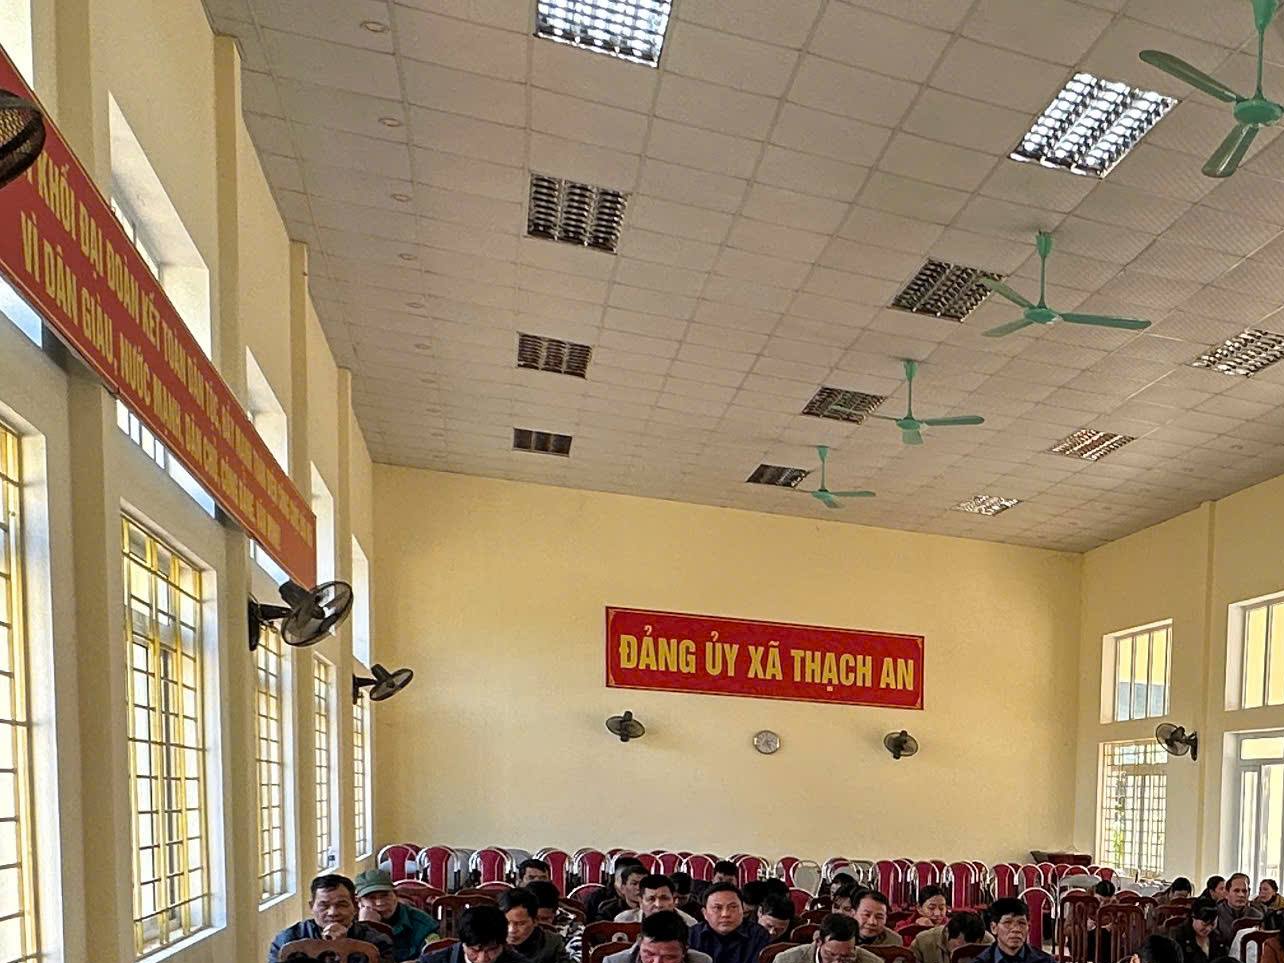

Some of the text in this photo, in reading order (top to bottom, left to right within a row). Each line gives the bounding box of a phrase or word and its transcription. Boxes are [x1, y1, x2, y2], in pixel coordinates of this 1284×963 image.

[20, 210, 40, 283] VÌ
[43, 238, 78, 327] DÂN
[81, 286, 118, 376] GIÀU,
[120, 331, 151, 406] NƯỚC
[37, 150, 77, 240] KHỐI
[79, 200, 104, 280] ĐẠI
[105, 238, 140, 326] ĐOÀN
[141, 289, 161, 352] KẾT
[619, 625, 915, 692] ĐẢNG ỦY XÃ THẠCH AN
